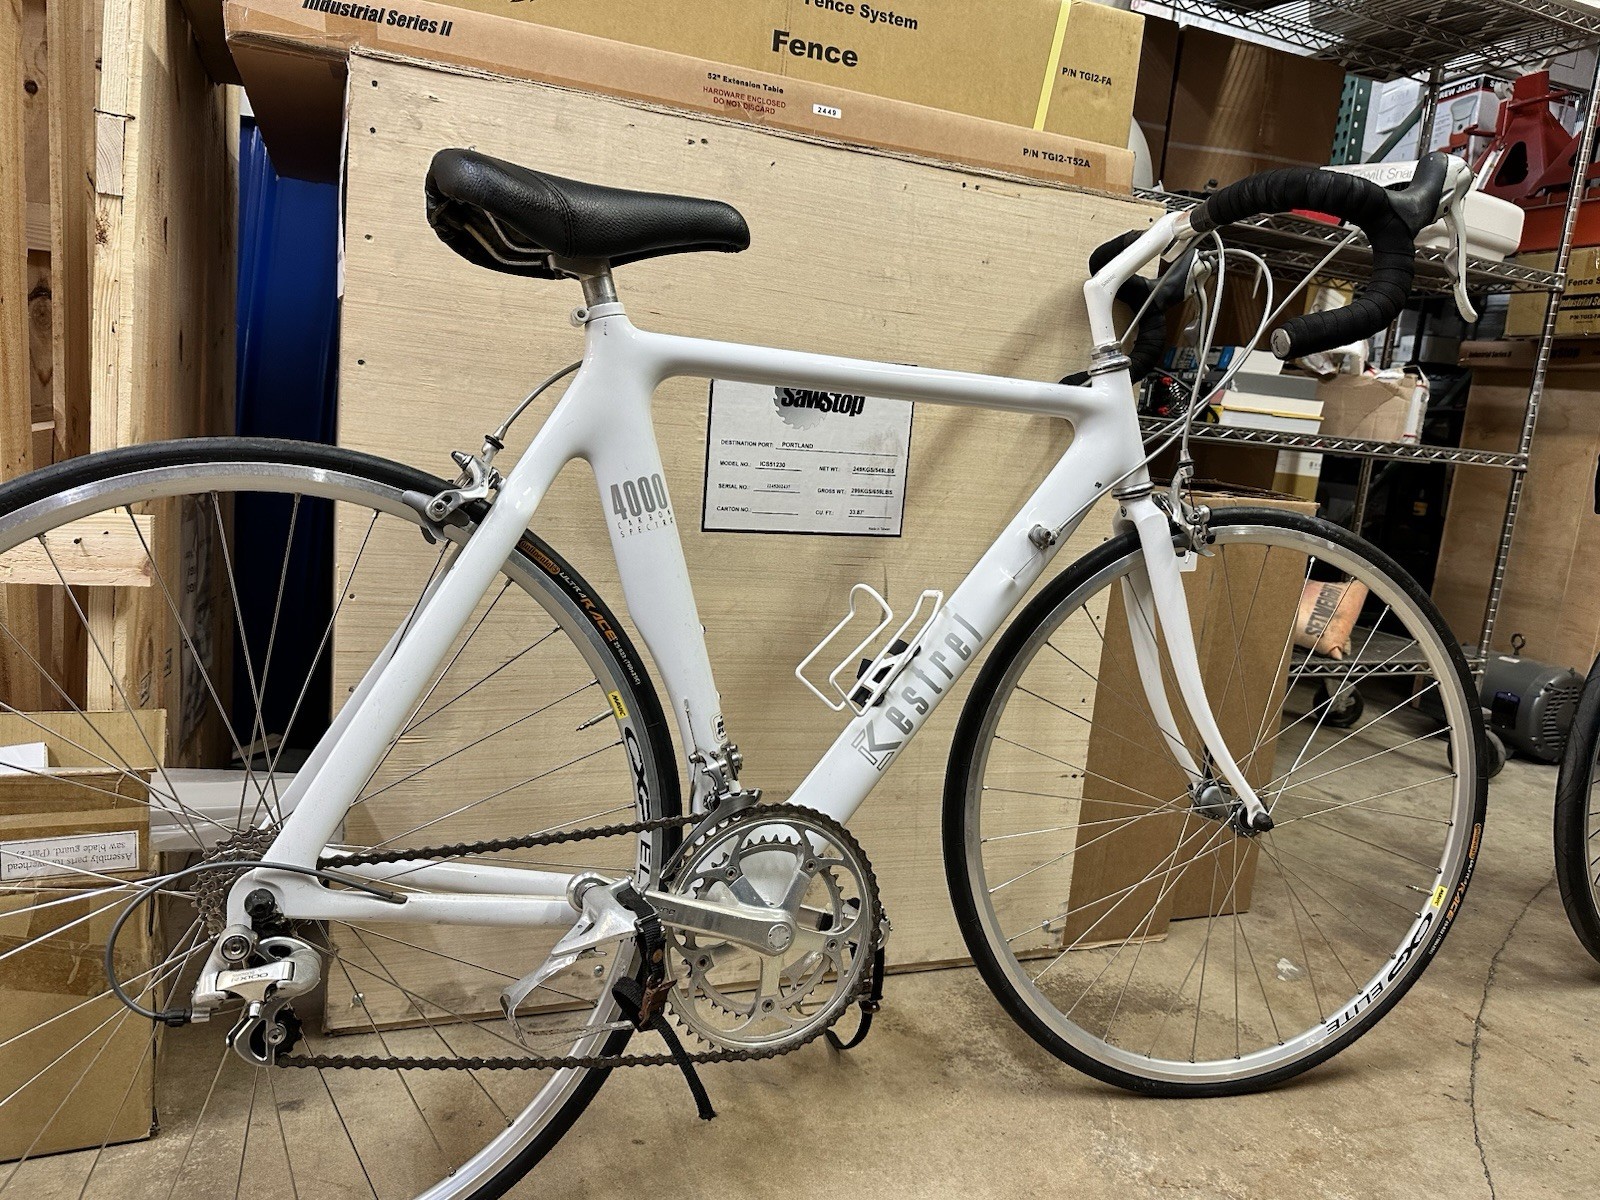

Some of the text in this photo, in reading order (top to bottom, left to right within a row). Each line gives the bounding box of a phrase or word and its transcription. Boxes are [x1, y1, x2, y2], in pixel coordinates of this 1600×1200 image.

[302, 0, 453, 37] Industrial Series II
[859, 4, 918, 30] System
[772, 29, 858, 67] Fence
[1062, 67, 1077, 78] P/N
[707, 72, 784, 94] 52" Extension Table
[1439, 88, 1454, 100] REW
[1456, 81, 1477, 94] JACK
[702, 86, 786, 109] HARDWARE ENCLOSED
[713, 96, 775, 115] DO NOT DISCARD
[817, 106, 837, 116] 2449
[1023, 148, 1039, 158] P/N
[721, 439, 757, 447] DESTINATION
[781, 441, 814, 449] PORTLAND
[610, 473, 668, 520] 4000
[559, 571, 587, 598] ULTRA
[580, 597, 617, 642] RACE
[851, 613, 983, 771] Kestrel
[611, 694, 626, 717] MAVIC
[28, 848, 50, 857] (Part
[53, 845, 81, 856] guard.
[83, 844, 106, 853] blade
[109, 842, 126, 851] saw
[66, 856, 88, 865] parts
[90, 852, 133, 864] Assembly
[1326, 981, 1384, 1035] ELITE
